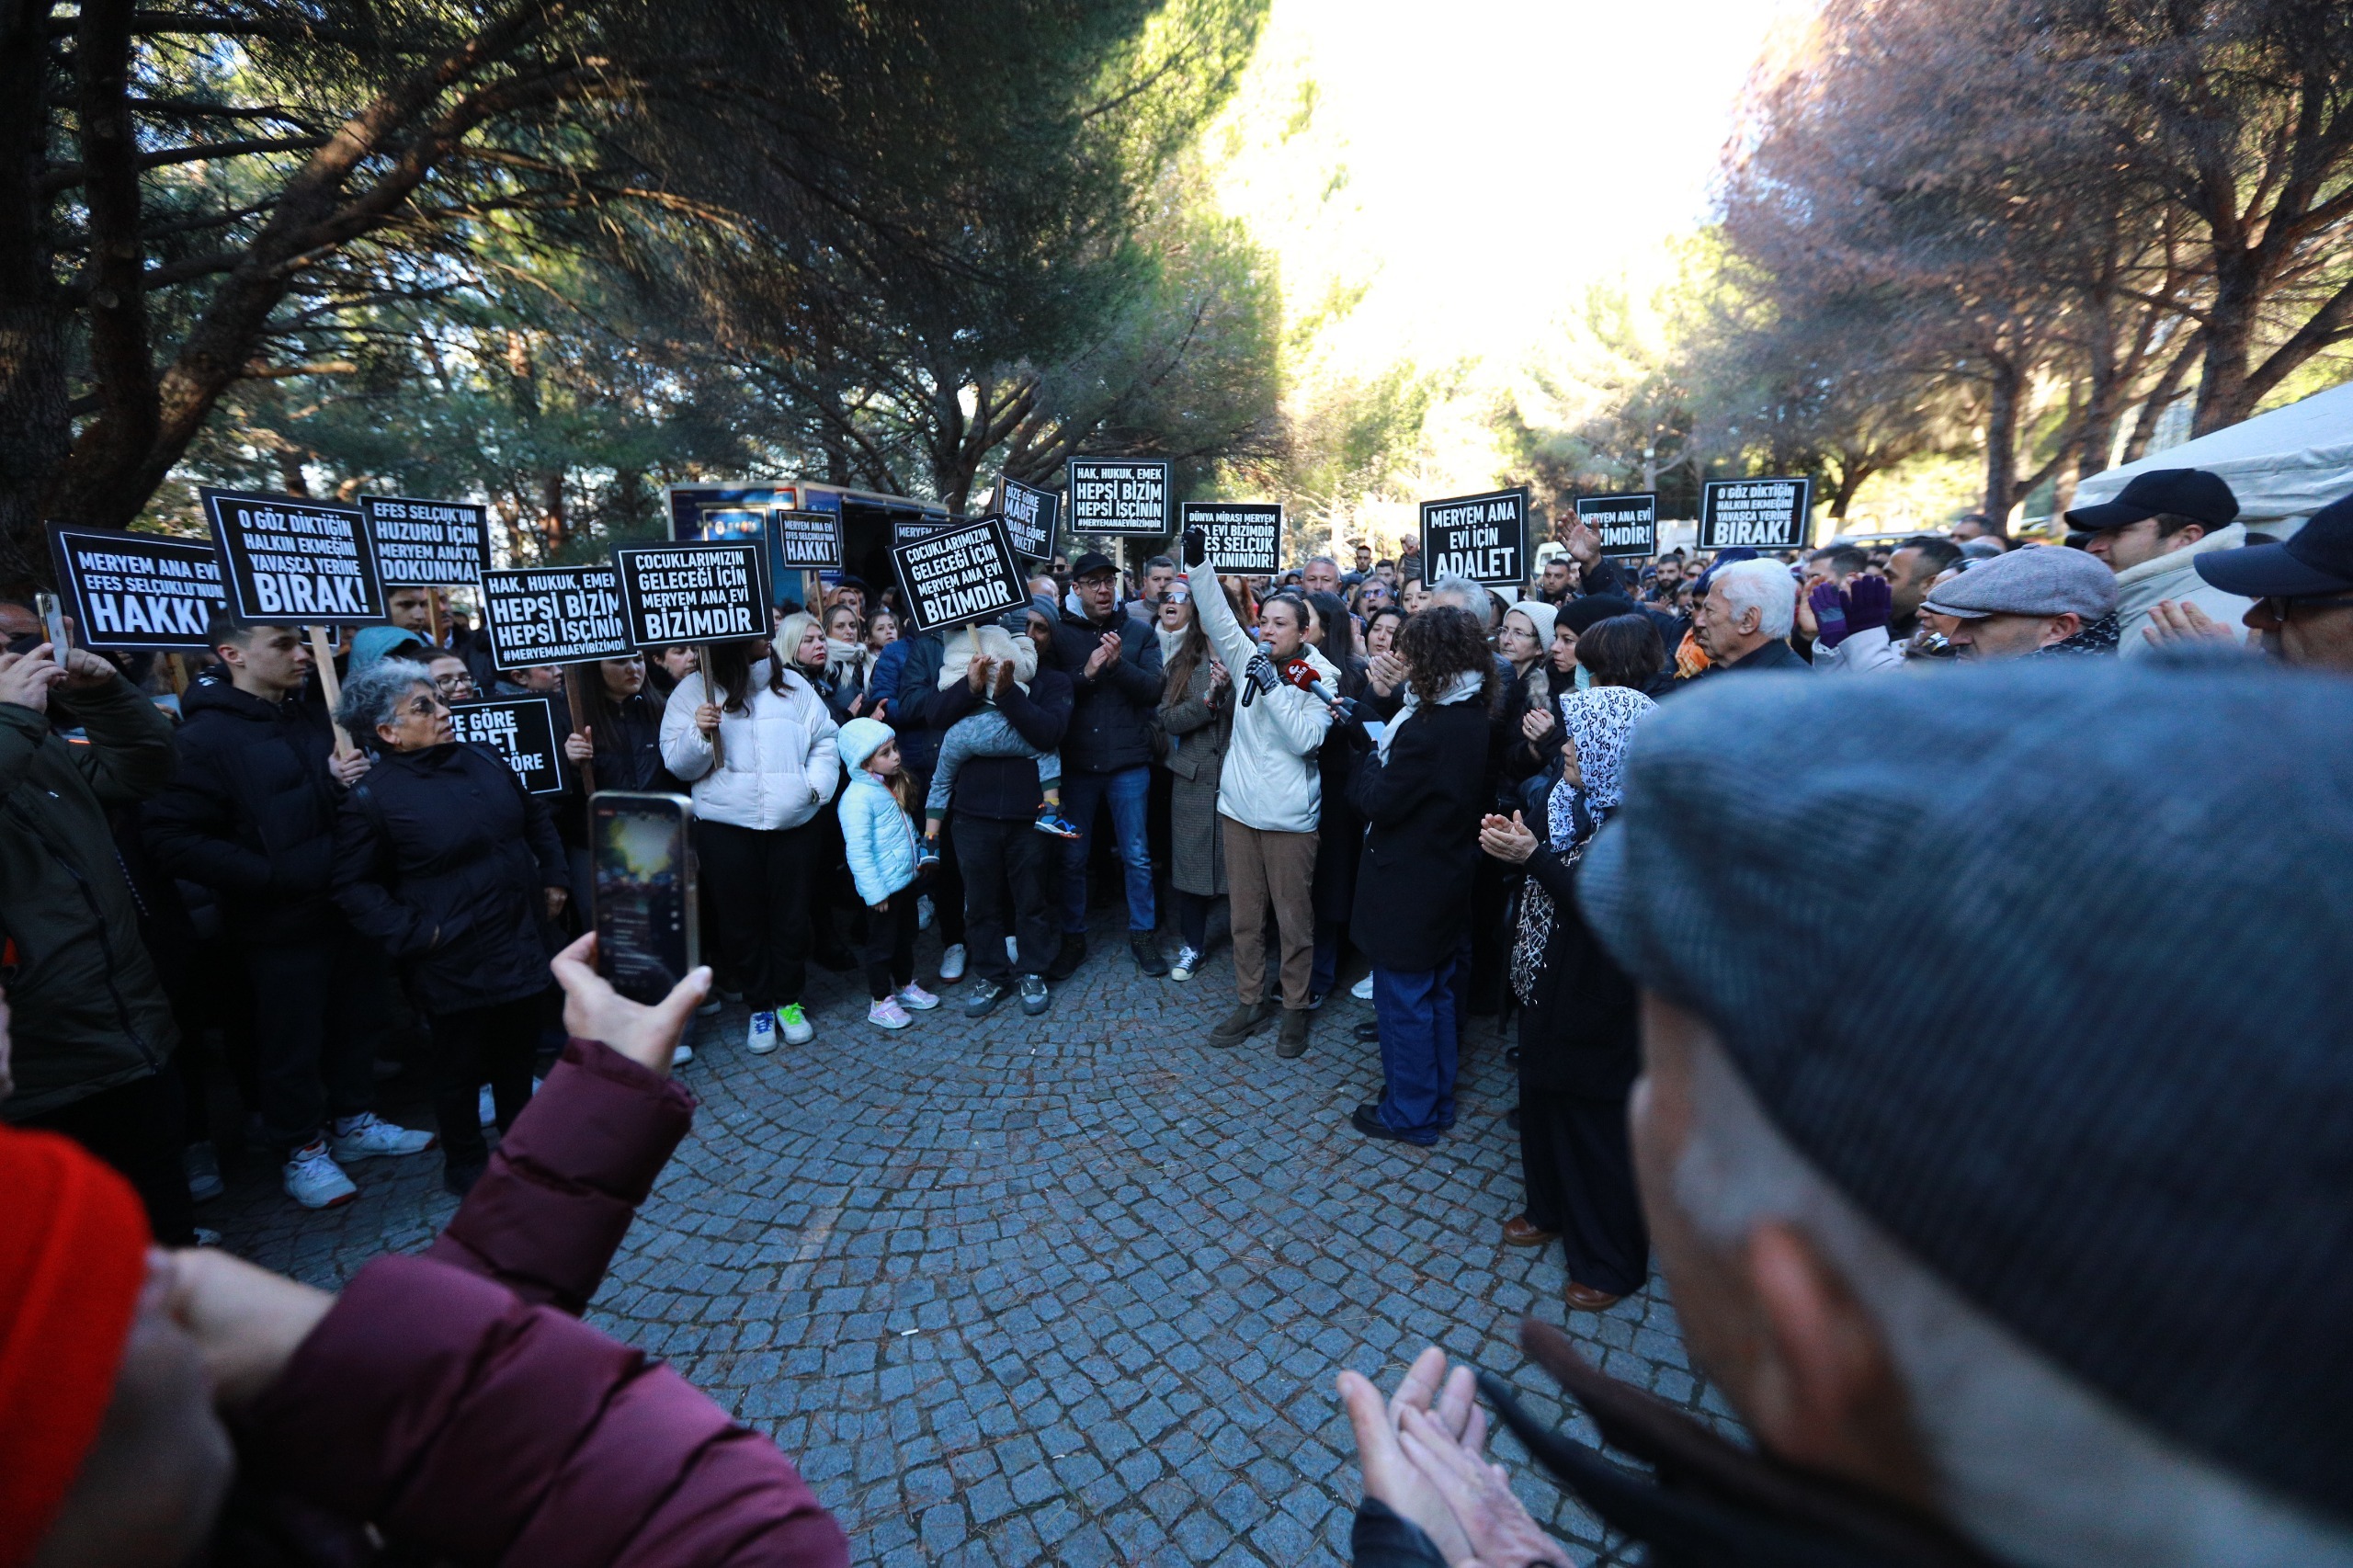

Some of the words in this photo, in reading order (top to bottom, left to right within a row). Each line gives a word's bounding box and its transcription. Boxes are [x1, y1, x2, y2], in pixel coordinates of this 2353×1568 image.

[1077, 468, 1099, 480] HAK,
[1101, 468, 1135, 480] HUKUK,
[1137, 469, 1162, 480] EMEK
[1006, 483, 1021, 501] BİZE
[1022, 490, 1040, 507] GÖRE
[1076, 480, 1118, 500] HEPSİ
[1122, 480, 1162, 500] BİZİM
[1718, 488, 1726, 499] O
[1727, 484, 1748, 499] GÖZ
[1749, 483, 1795, 498] DİKTİĞİN
[373, 502, 406, 518] EFES
[409, 505, 477, 524] SELÇUK'UN
[1004, 497, 1039, 525] MABET
[1076, 499, 1112, 517] HEPSİ
[1116, 499, 1162, 517] İŞÇİNİN
[1431, 506, 1483, 528] MERYEM
[1487, 501, 1516, 522] ANA
[1618, 511, 1635, 522] ANA
[1637, 506, 1651, 521] EVİ
[1716, 500, 1750, 510] HALKIN
[1751, 497, 1794, 509] EKMEĞİNİ
[237, 509, 252, 528] O
[254, 507, 288, 532] GÖZ
[289, 510, 354, 538] DİKTİĞİN
[784, 519, 810, 531] MERYEM
[811, 521, 824, 532] ANA
[824, 521, 834, 532] EVİ
[1078, 518, 1161, 528] #MERYEMANAEVİBİZİMDİR
[1189, 510, 1214, 522] DÜNYA
[1216, 511, 1242, 522] MİRASI
[1244, 514, 1276, 523] MERYEM
[1758, 509, 1792, 521] YERİNE
[375, 521, 443, 542] HUZURU
[447, 521, 479, 546] İÇİN
[785, 531, 798, 540] EFES
[1026, 525, 1047, 541] GÖRE
[1212, 521, 1228, 537] EVİ
[1230, 522, 1275, 538] BİZİMDİR
[1449, 526, 1470, 550] EVİ
[1472, 523, 1498, 549] İÇİN
[1713, 521, 1791, 545] BIRAK!
[243, 533, 297, 552] HALKIN
[297, 537, 358, 556] EKMEĞİNİ
[378, 543, 434, 560] MERYEM
[438, 546, 481, 561] ANA'YA
[786, 540, 830, 562] HAKKI
[906, 527, 992, 564] ÇOCUKLARIMIZIN
[1010, 533, 1036, 553] RKET!
[1223, 537, 1275, 553] SELÇUK
[77, 551, 156, 575] MERYEM
[159, 559, 194, 578] ANA
[194, 560, 222, 581] EVİ
[313, 555, 362, 576] YERİNE
[381, 559, 481, 581] DOKUNMA!
[635, 551, 745, 572] ÇOCUKLARIMIZIN
[911, 548, 970, 582] GELECEĞİ
[970, 542, 998, 566] İÇİN
[1211, 552, 1275, 568] KININDIR!
[1435, 547, 1515, 581] ADALET
[84, 574, 123, 592] EFES
[126, 576, 225, 598] SELÇUKLU'NUN
[488, 577, 525, 594] HAK,
[527, 574, 580, 592] HUKUK,
[638, 567, 713, 591] GELECEĞİ
[716, 565, 747, 588] İÇİN
[917, 574, 961, 597] MERYEM
[962, 567, 984, 585] ANA
[984, 559, 1004, 578] EVİ
[252, 573, 369, 613] BIRAK!
[642, 591, 698, 608] MERYEM
[700, 589, 727, 605] ANA
[730, 585, 749, 603] EVİ
[923, 578, 1012, 624] BİZİMDİR
[88, 593, 210, 634] HAKKI
[492, 592, 561, 623] HEPSİ
[644, 603, 753, 640] BİZİMDİR
[496, 619, 557, 647] HEPSİ
[470, 708, 517, 731] GÖRE
[503, 751, 544, 772] ÖRE
